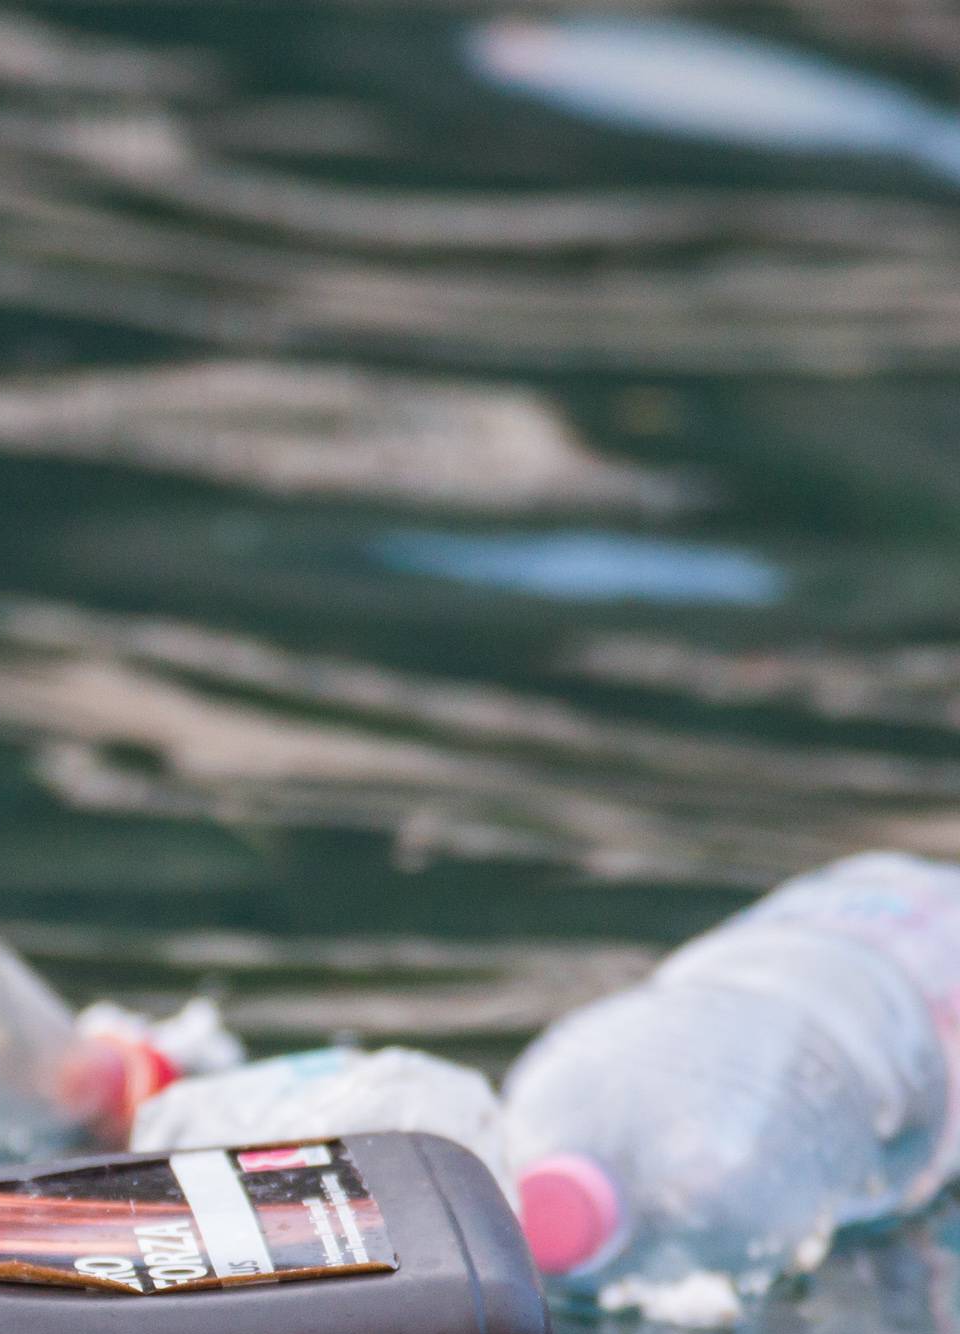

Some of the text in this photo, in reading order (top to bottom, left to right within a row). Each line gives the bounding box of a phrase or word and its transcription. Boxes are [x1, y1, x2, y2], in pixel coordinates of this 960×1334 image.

[134, 1219, 208, 1289] FORZA
[228, 1260, 260, 1276] US
[73, 1256, 144, 1292] RO
